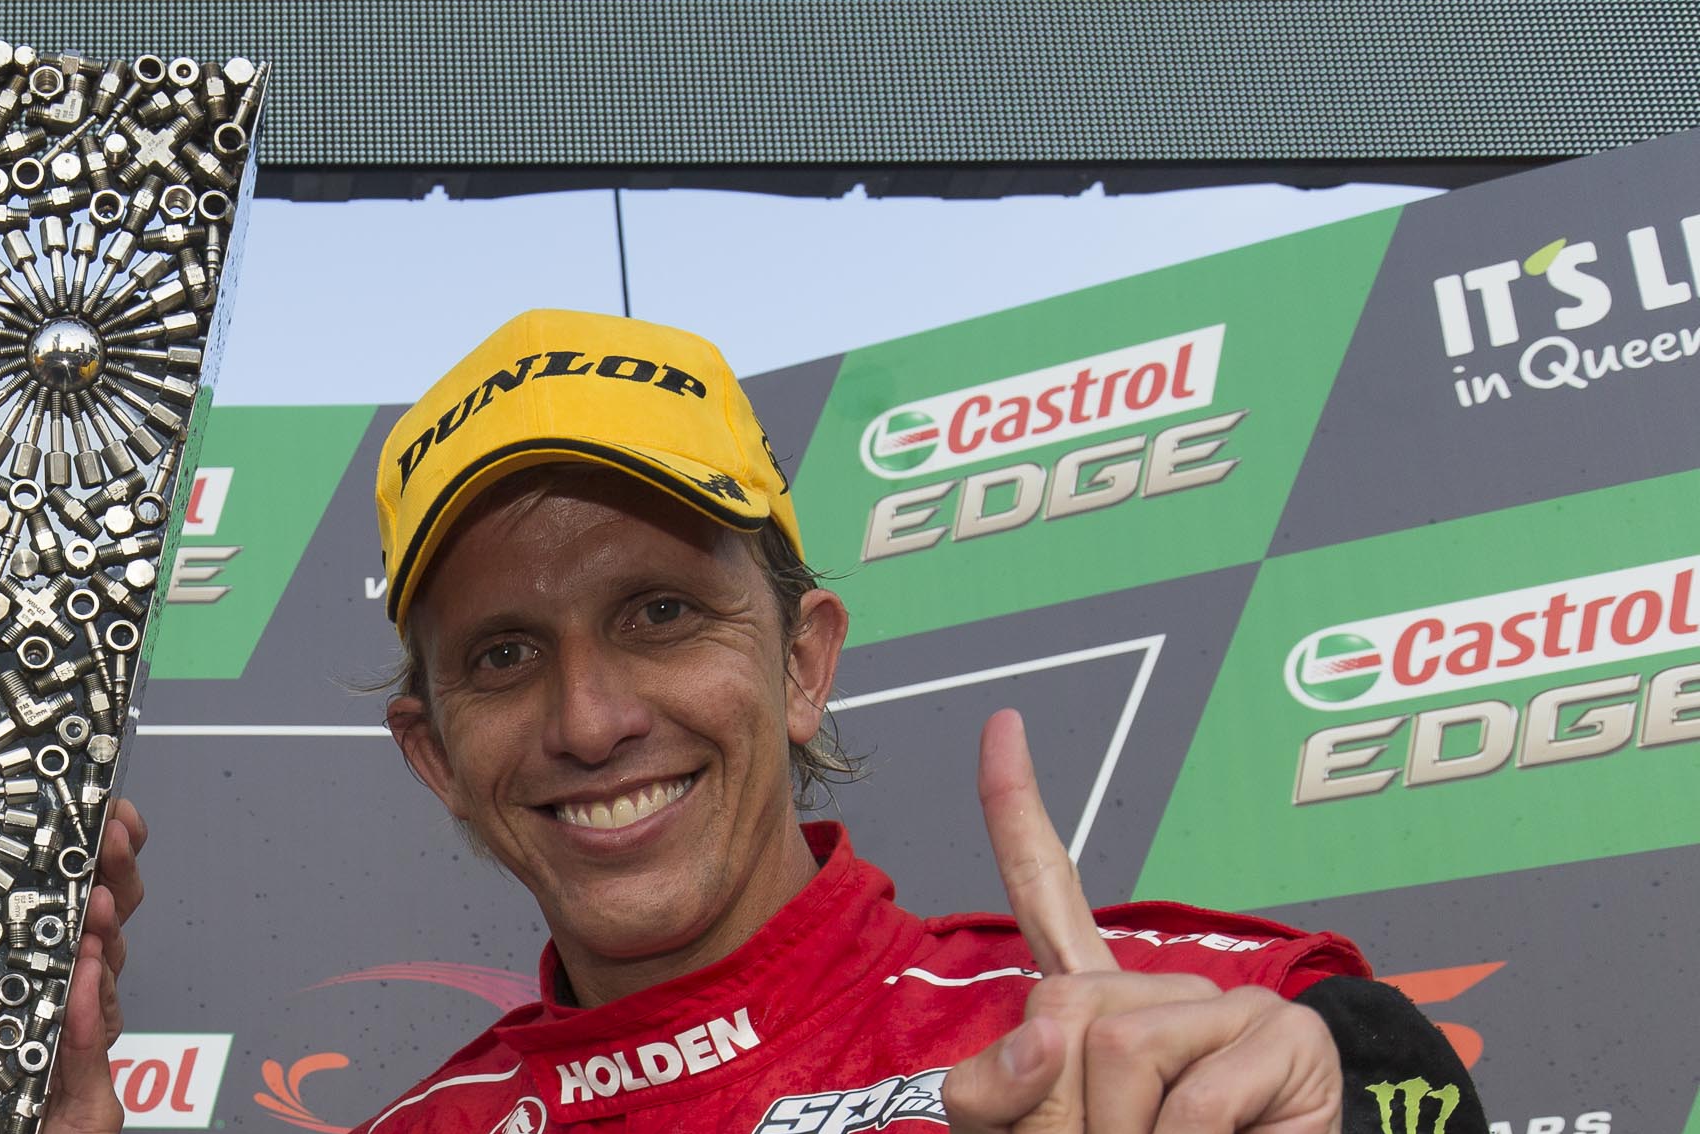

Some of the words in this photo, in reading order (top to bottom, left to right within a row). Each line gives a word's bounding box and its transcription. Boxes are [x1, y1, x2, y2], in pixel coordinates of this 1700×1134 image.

[1433, 238, 1612, 358] IT'S
[397, 351, 707, 499] DUNLOP
[946, 341, 1196, 455] Castrol
[1452, 365, 1512, 408] in
[1518, 327, 1700, 390] Queen
[859, 408, 1252, 564] EDGE
[1392, 567, 1700, 686] Castrol
[1291, 662, 1700, 808] EDGE
[1097, 926, 1277, 952] OLDEN
[555, 1007, 761, 1105] HOLDEN
